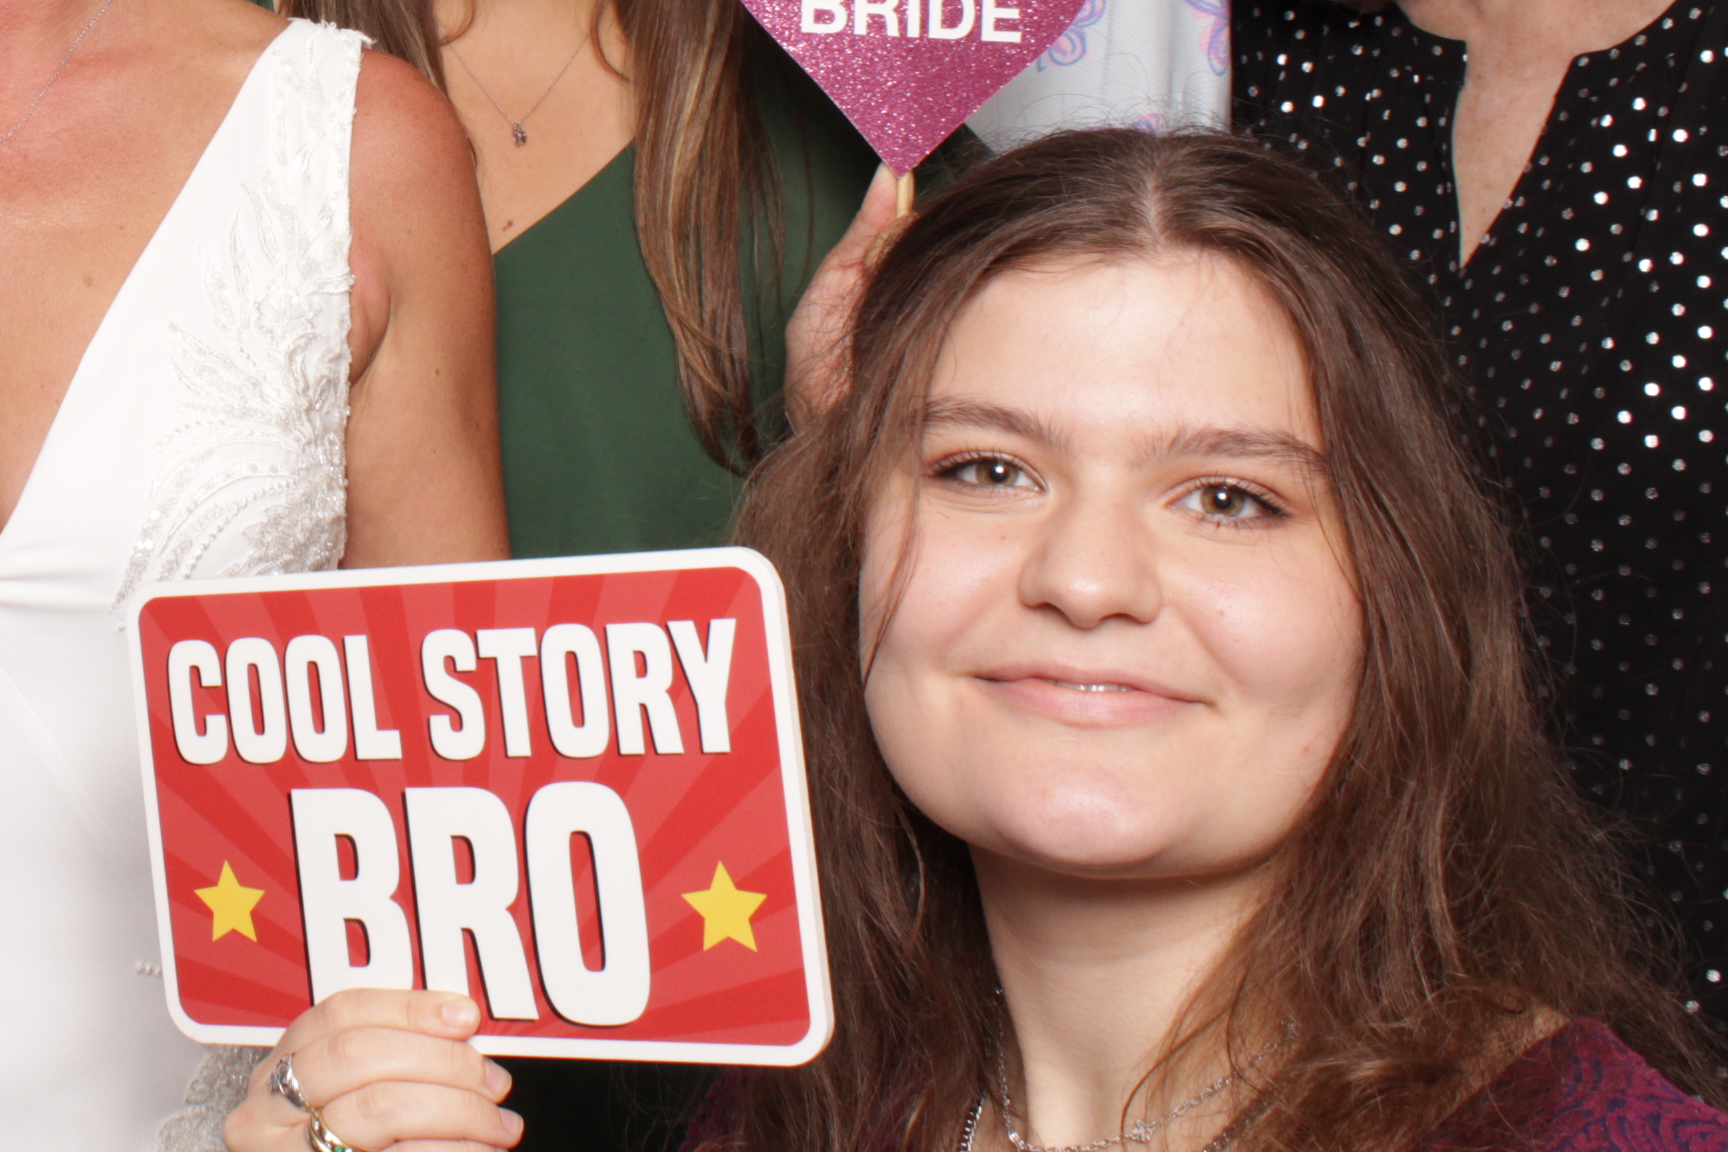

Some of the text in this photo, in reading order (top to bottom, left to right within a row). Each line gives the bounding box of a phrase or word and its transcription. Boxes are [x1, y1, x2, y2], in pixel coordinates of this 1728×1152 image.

[167, 617, 737, 765] COOL STORY
[289, 780, 652, 1026] BRO
